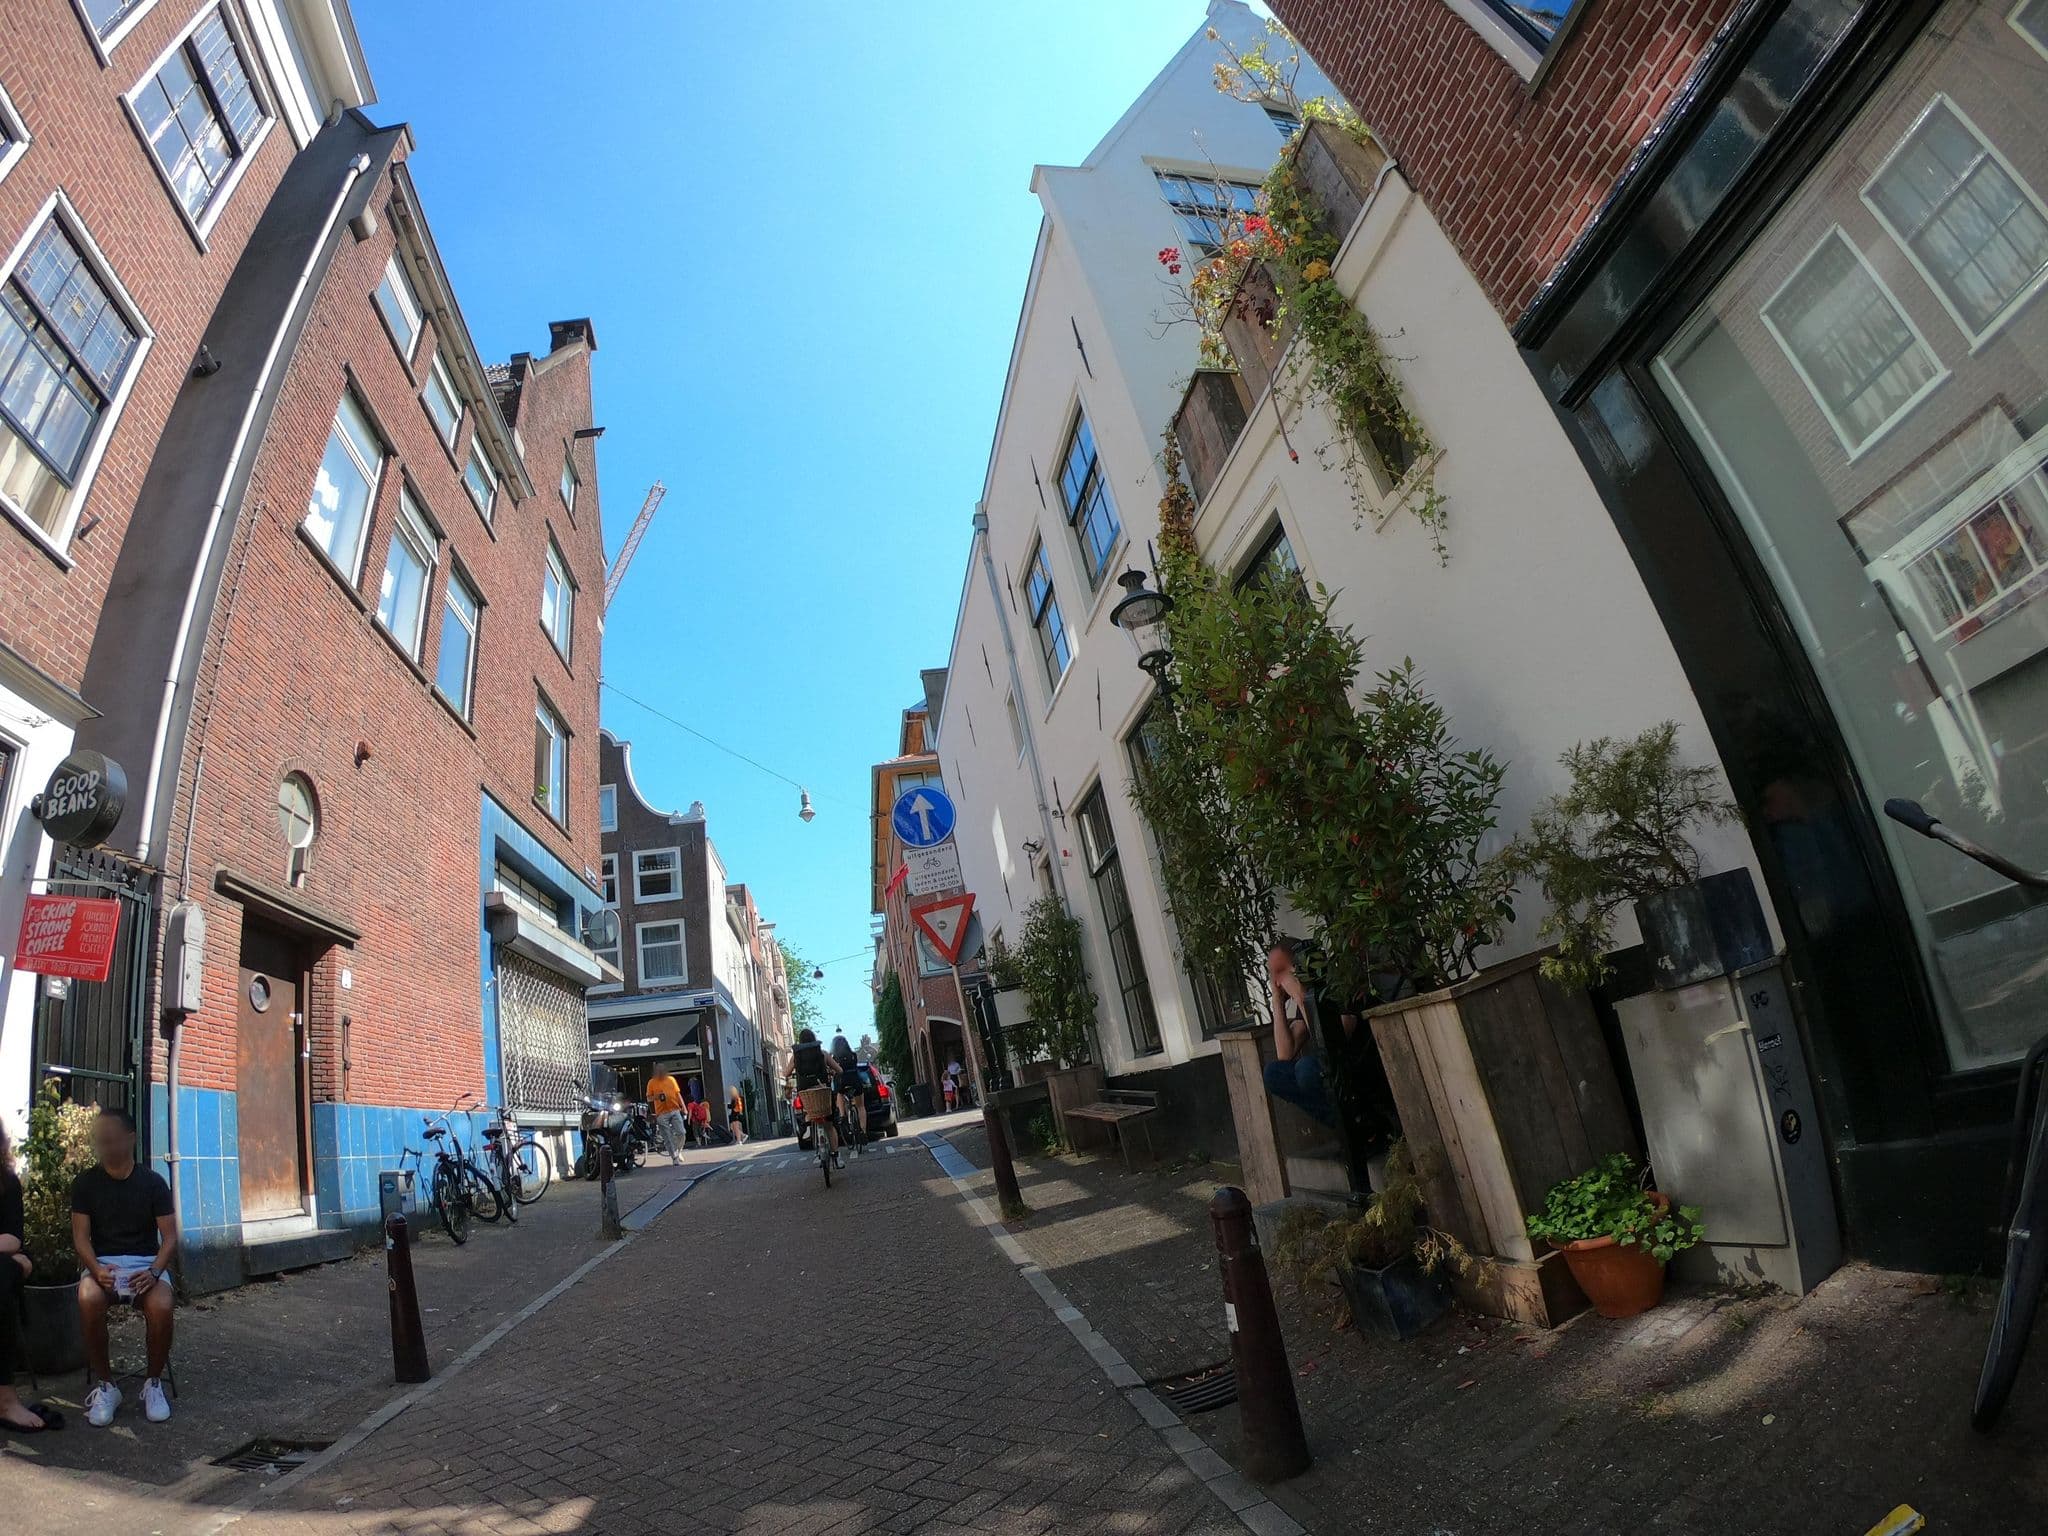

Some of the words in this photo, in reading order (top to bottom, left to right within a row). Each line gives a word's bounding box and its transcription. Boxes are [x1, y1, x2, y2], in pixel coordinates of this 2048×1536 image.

[53, 770, 99, 798] GOOD
[46, 789, 97, 819] BEANS
[907, 845, 953, 860] uitgezonderd
[26, 918, 72, 939] STRONG
[26, 934, 67, 956] COFFEE
[596, 1036, 660, 1049] vintage
